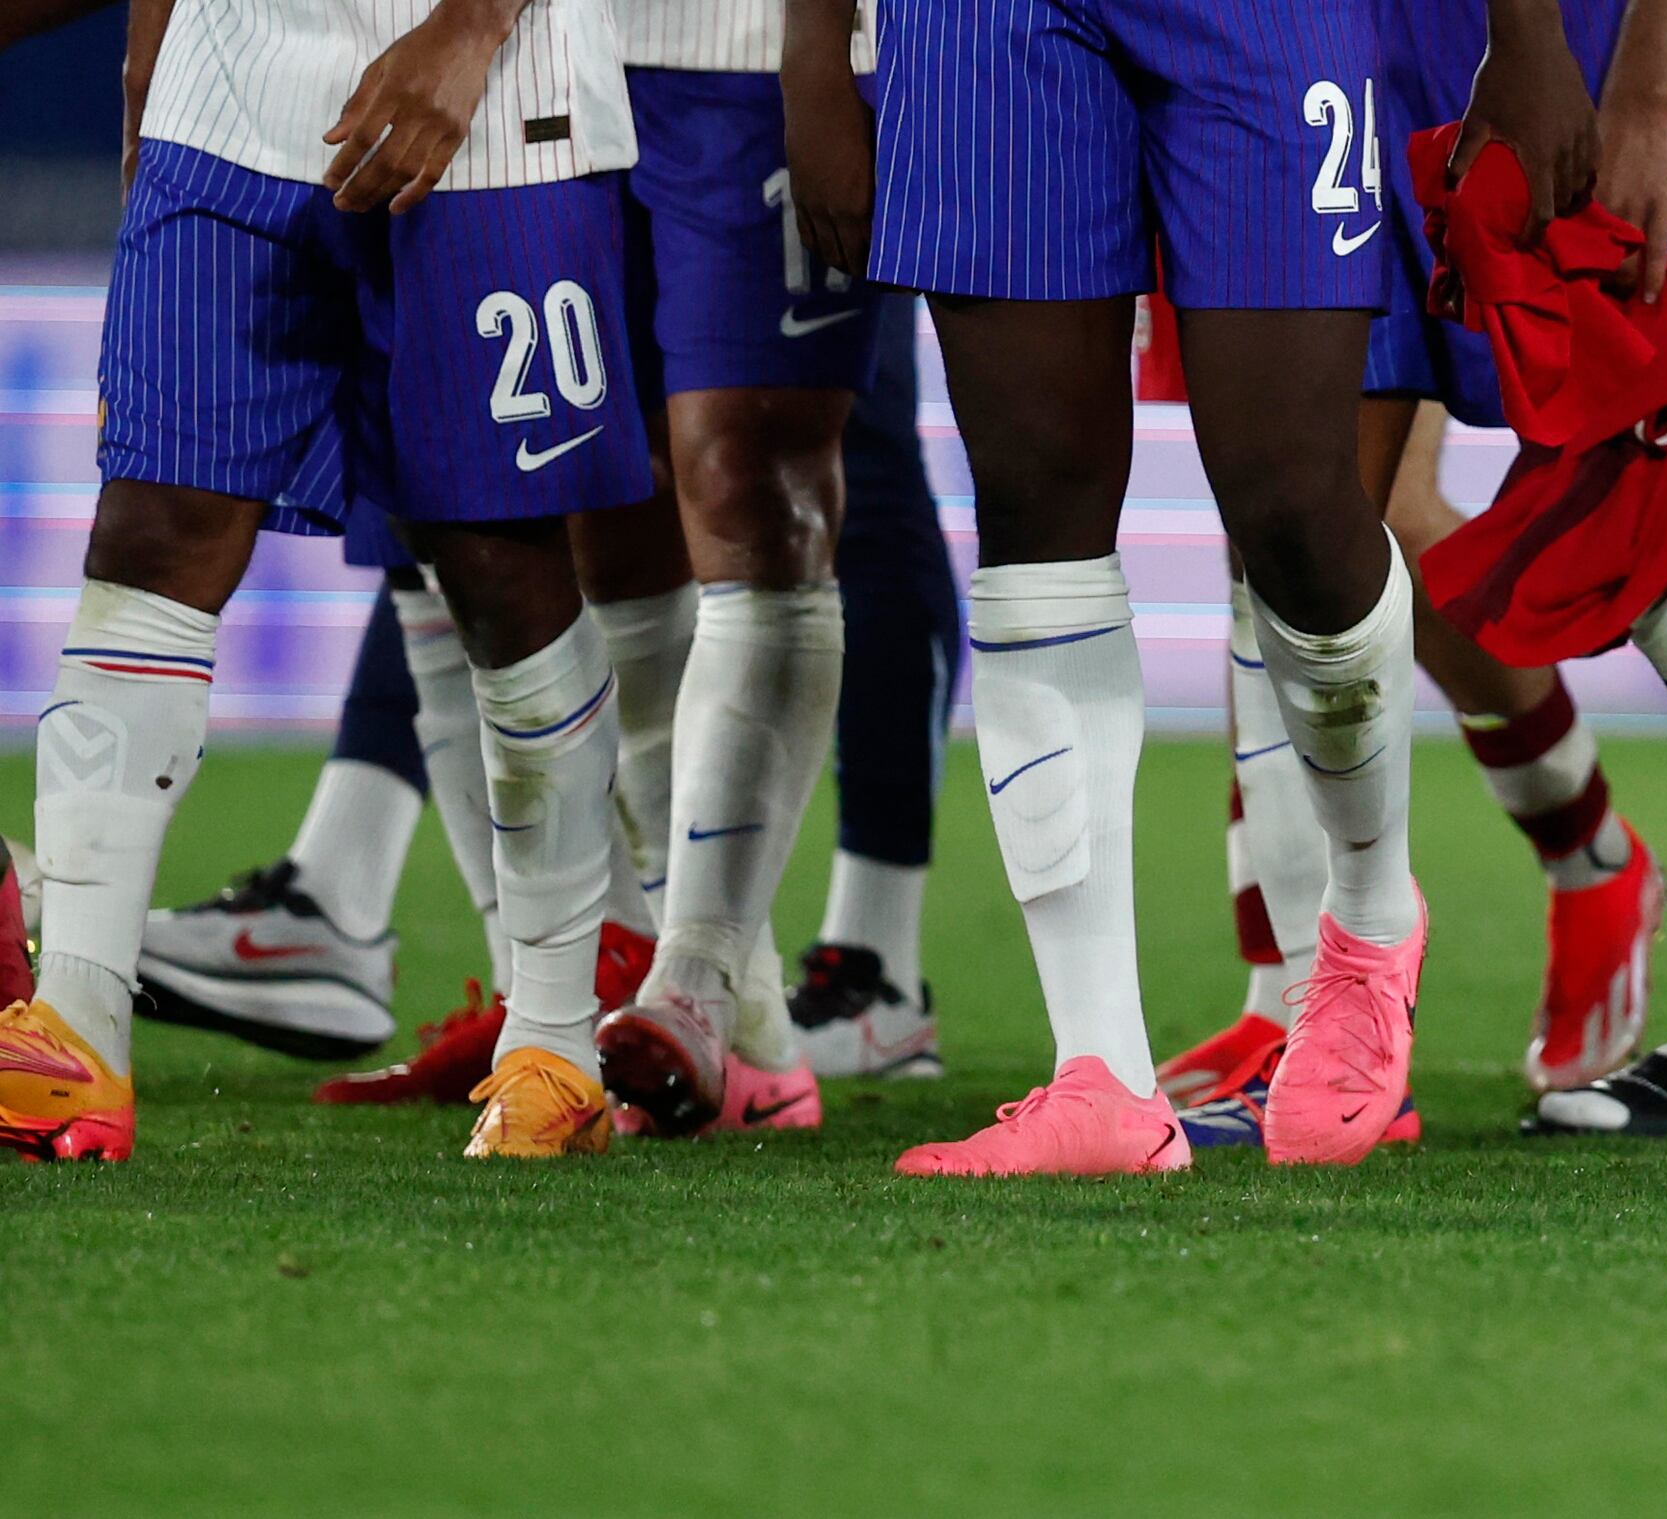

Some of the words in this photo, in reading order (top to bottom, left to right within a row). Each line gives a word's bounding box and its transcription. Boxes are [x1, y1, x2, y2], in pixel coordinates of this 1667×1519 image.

[1303, 78, 1383, 214] 24
[763, 168, 851, 293] 1
[476, 280, 607, 424] 20
